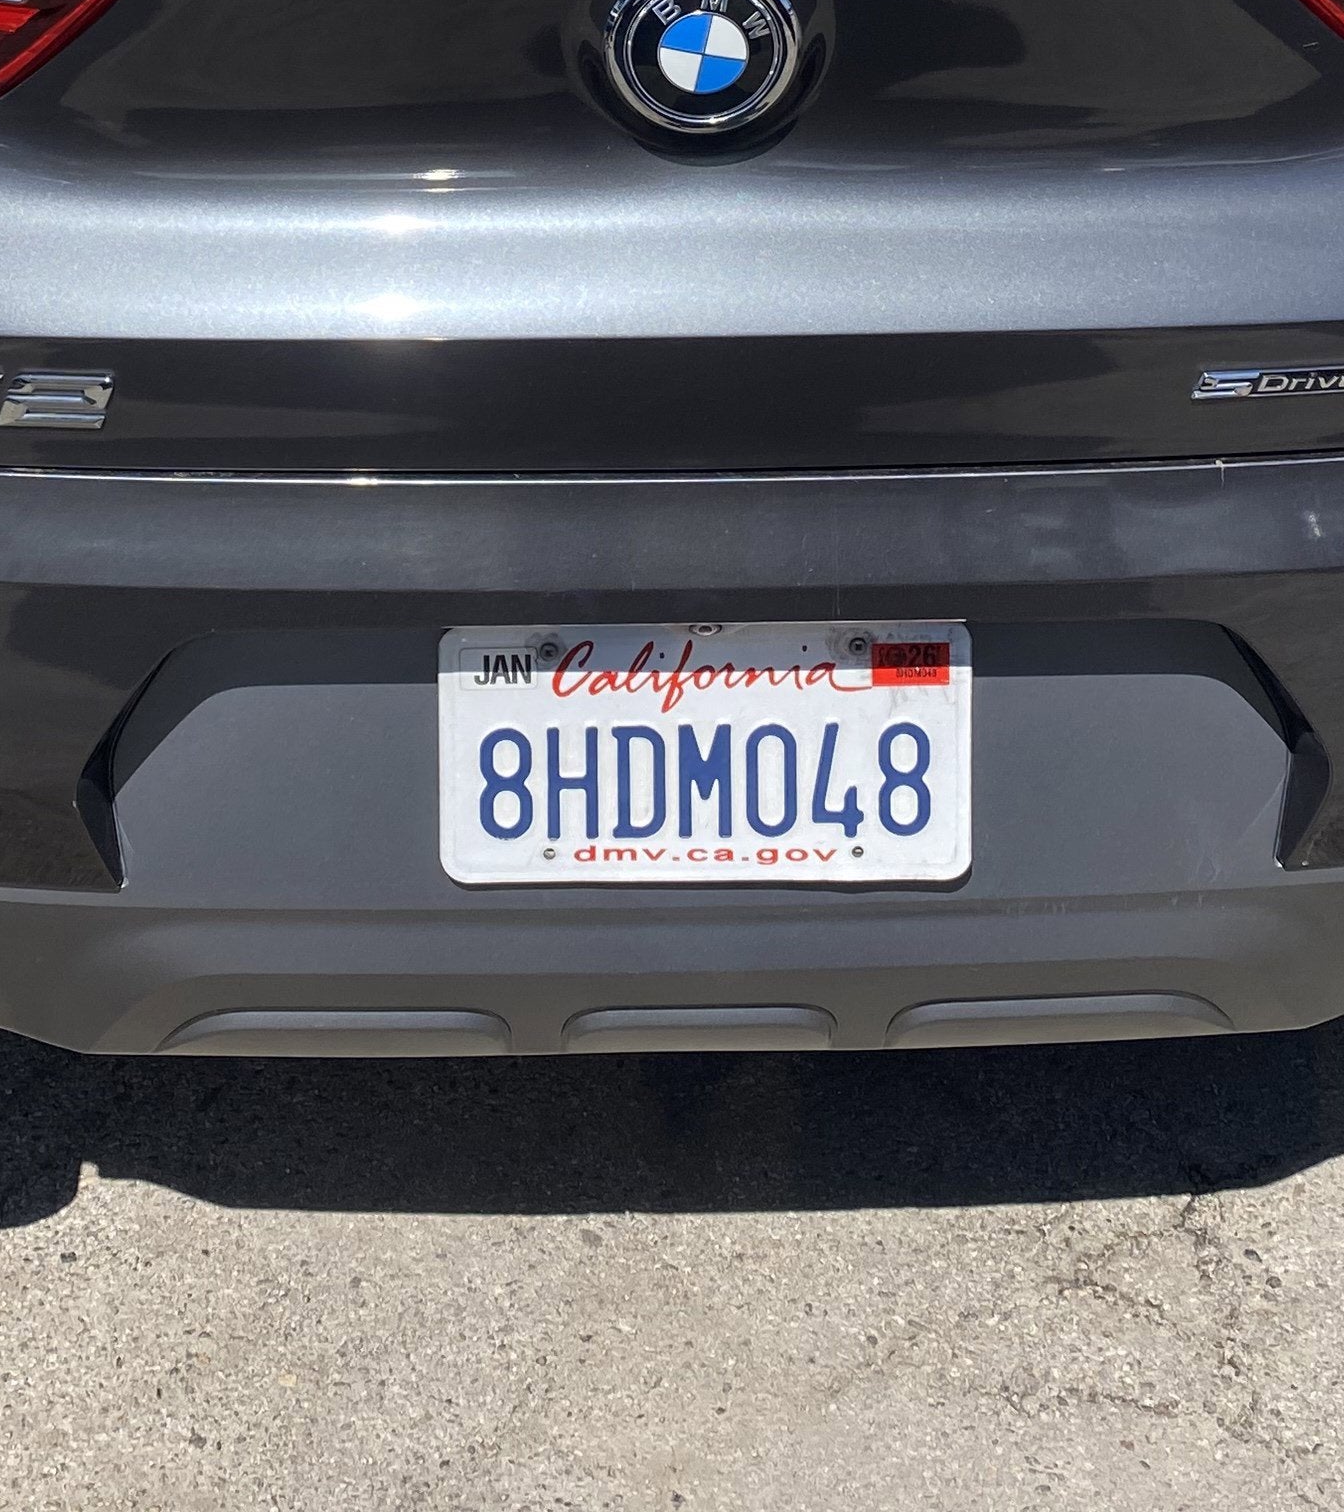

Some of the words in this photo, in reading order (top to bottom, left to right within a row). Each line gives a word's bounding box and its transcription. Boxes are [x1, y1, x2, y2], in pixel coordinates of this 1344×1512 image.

[474, 653, 533, 685] JAN
[552, 639, 873, 713] California
[478, 721, 932, 839] 8HDM048
[573, 843, 839, 866] dmv.ca.gov
